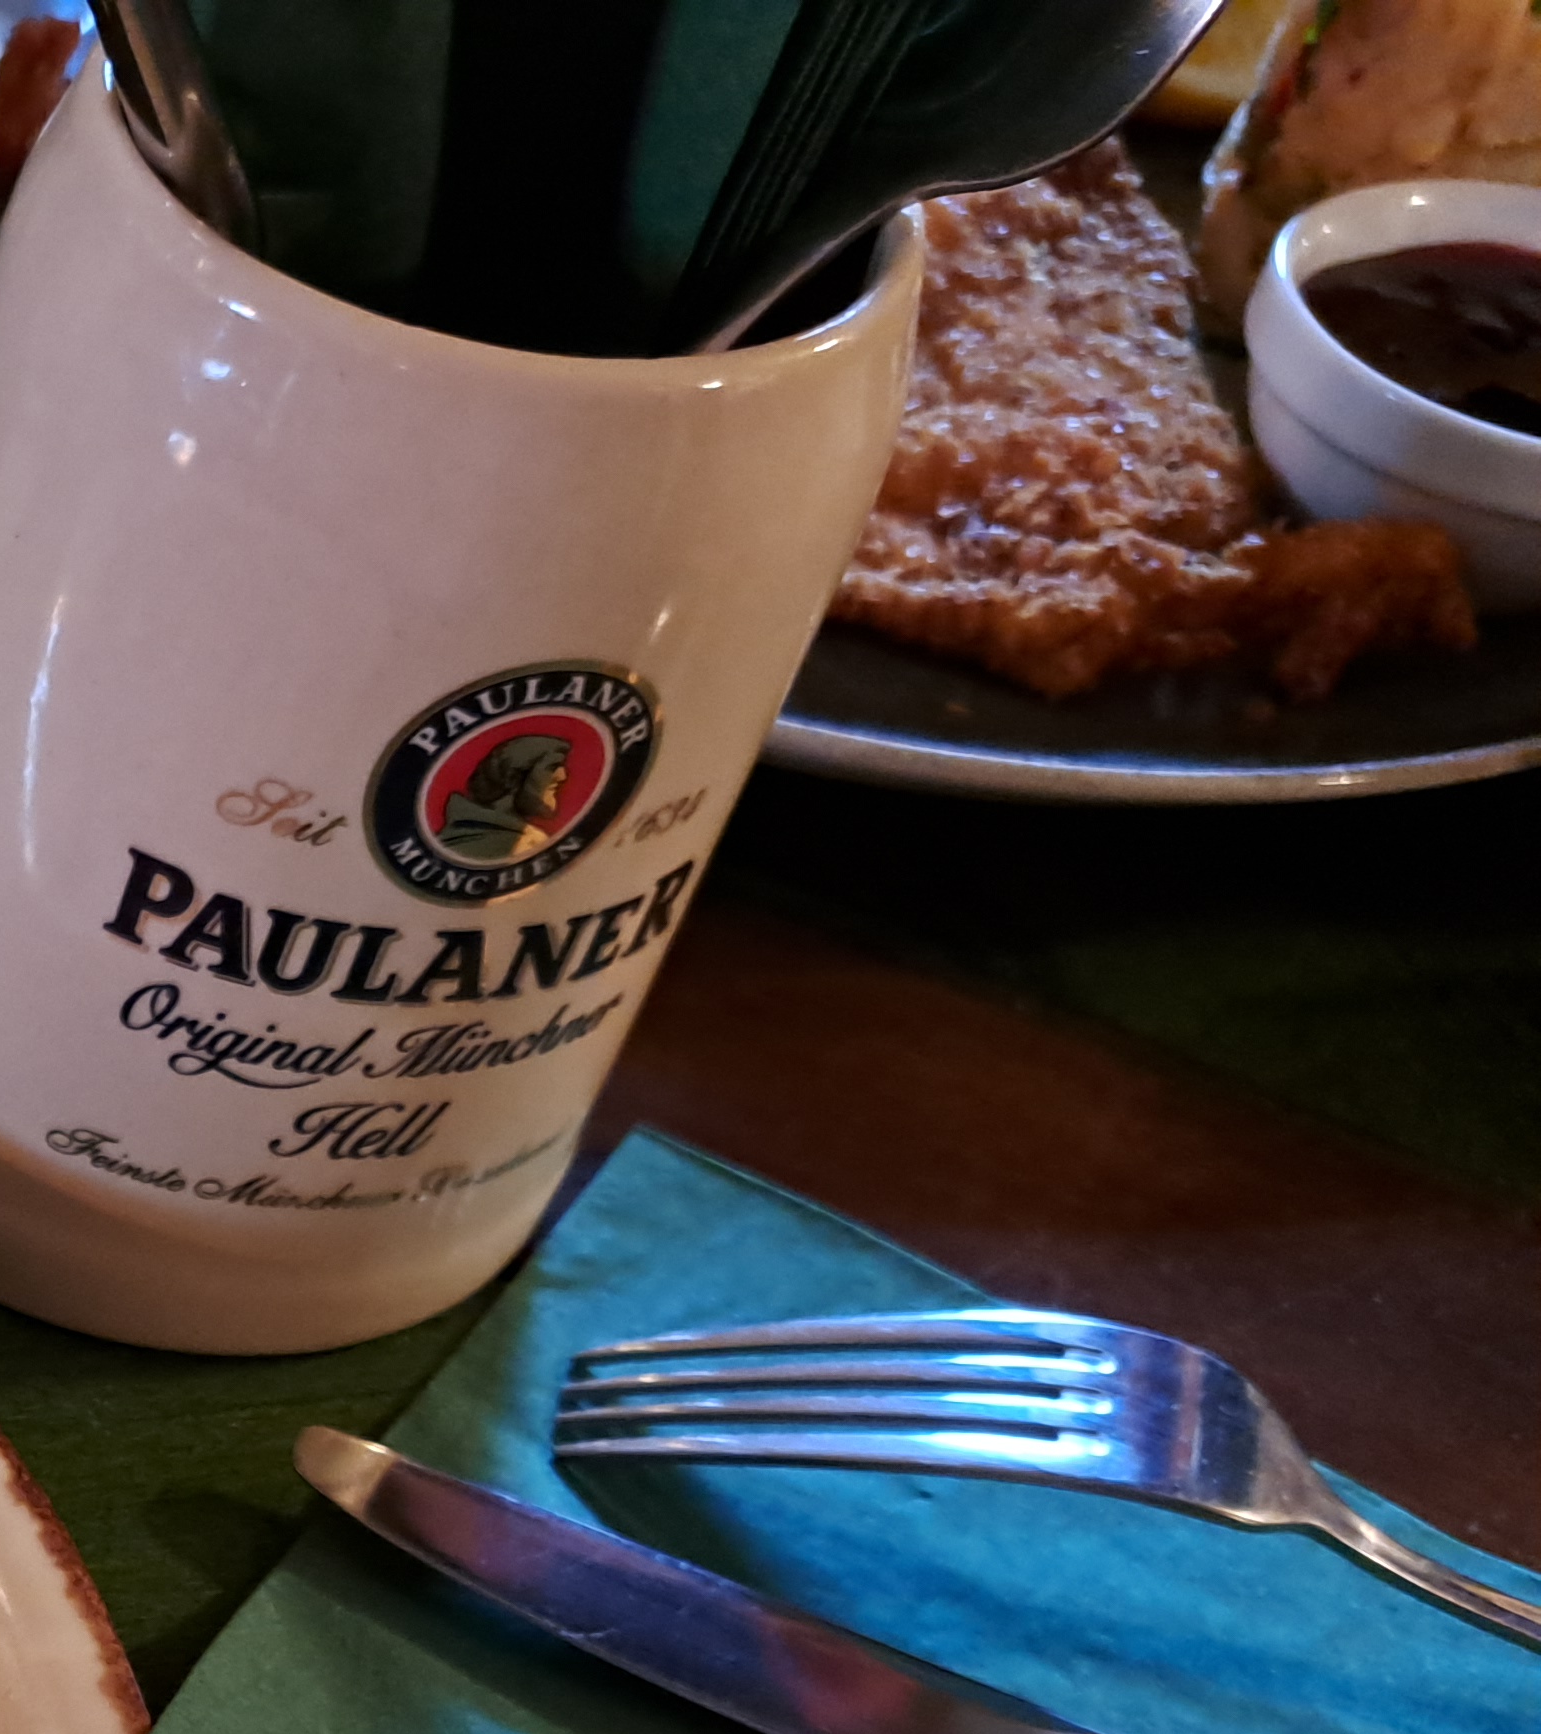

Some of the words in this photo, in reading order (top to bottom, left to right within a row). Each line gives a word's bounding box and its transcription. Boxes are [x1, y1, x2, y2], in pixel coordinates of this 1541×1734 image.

[408, 675, 650, 756] PAULANER
[216, 779, 348, 846] Seit
[103, 846, 694, 1008] PAULANER
[119, 983, 376, 1089] Original
[362, 993, 624, 1080] Münchner
[45, 1128, 186, 1193] Feinste
[268, 1101, 452, 1161] Hell
